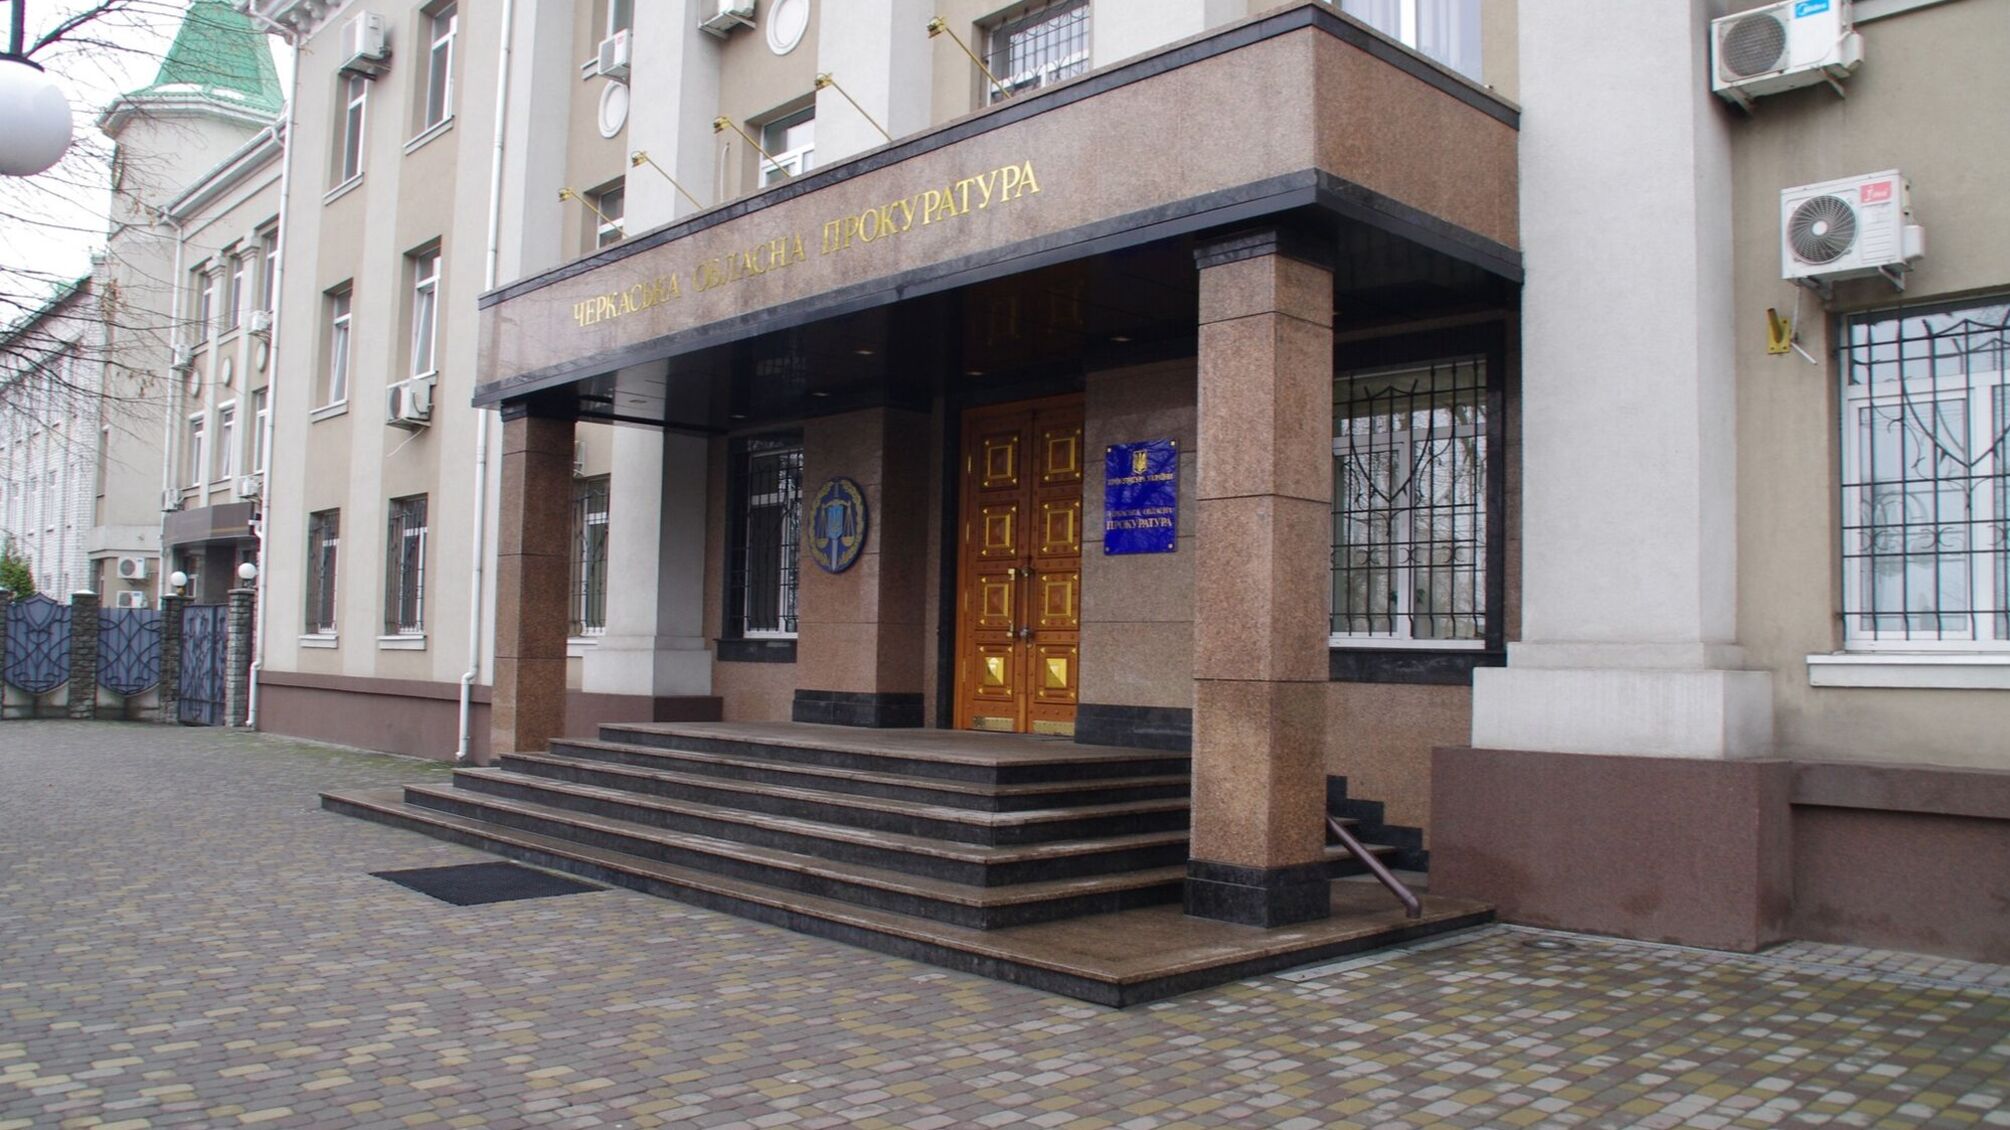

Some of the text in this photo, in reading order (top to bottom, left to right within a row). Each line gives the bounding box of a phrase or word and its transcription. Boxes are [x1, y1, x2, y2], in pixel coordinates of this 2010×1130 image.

[573, 159, 1041, 327] ЧЕРКАСЬКА ОБЛАСНА ПРОКУРАТУРА
[1106, 517, 1172, 530] ПРОКУРАТУРА
